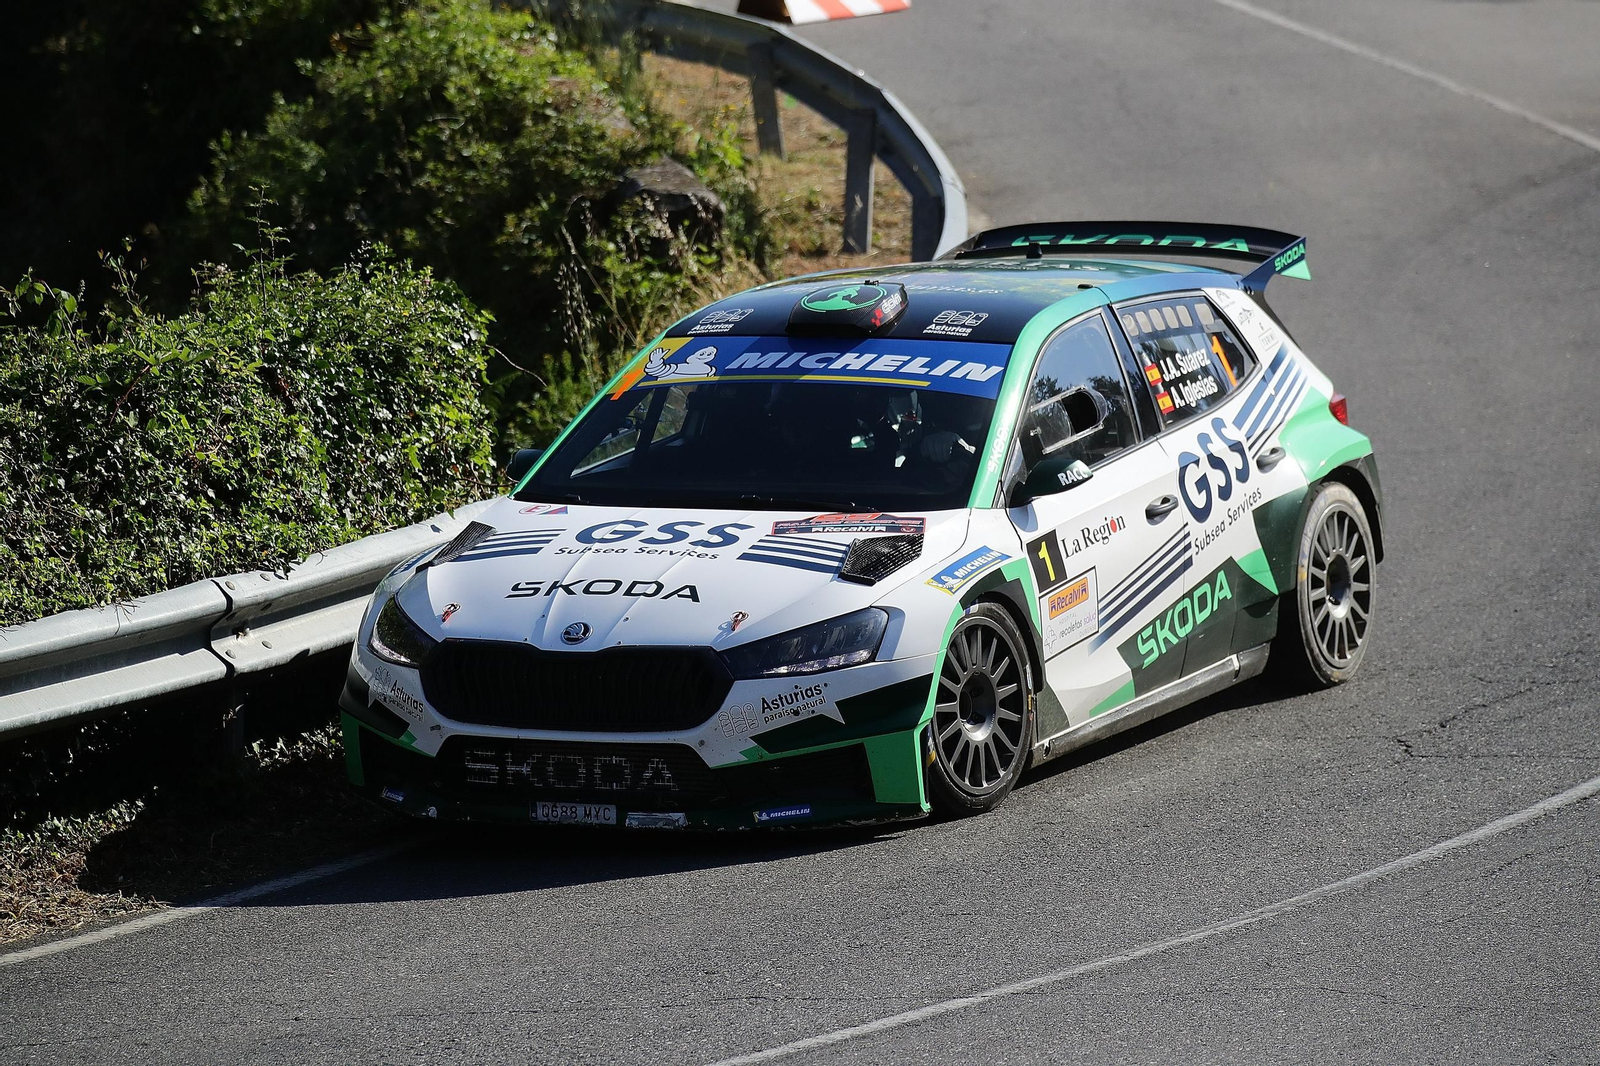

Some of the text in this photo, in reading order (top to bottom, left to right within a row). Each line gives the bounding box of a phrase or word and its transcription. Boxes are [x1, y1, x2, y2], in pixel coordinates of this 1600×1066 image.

[1274, 243, 1306, 272] SKODA
[926, 323, 973, 334] Asturias
[724, 351, 1005, 384] MICHELIN
[1159, 346, 1211, 382] J.A. Suárez
[1211, 335, 1238, 388] 1
[1169, 373, 1219, 410] A. Iglesias
[1177, 416, 1251, 524] GSS
[575, 519, 756, 549] GSS
[823, 525, 875, 533] Recalvi
[1193, 486, 1263, 556] Subsea Services
[553, 546, 720, 560] Subsea Services
[1038, 540, 1056, 582] 1
[1060, 537, 1082, 560] La
[953, 550, 1003, 579] MICHELIN
[504, 578, 701, 604] SKODA
[1055, 584, 1081, 612] Recalvi
[1137, 569, 1233, 670] SKODA
[390, 679, 424, 713] Asturias
[760, 683, 823, 714] Asturias
[763, 696, 827, 725] paraíso natural
[464, 750, 680, 791] SKODA
[541, 803, 611, 822] 0688 MYC
[769, 807, 811, 818] MICHELIN
